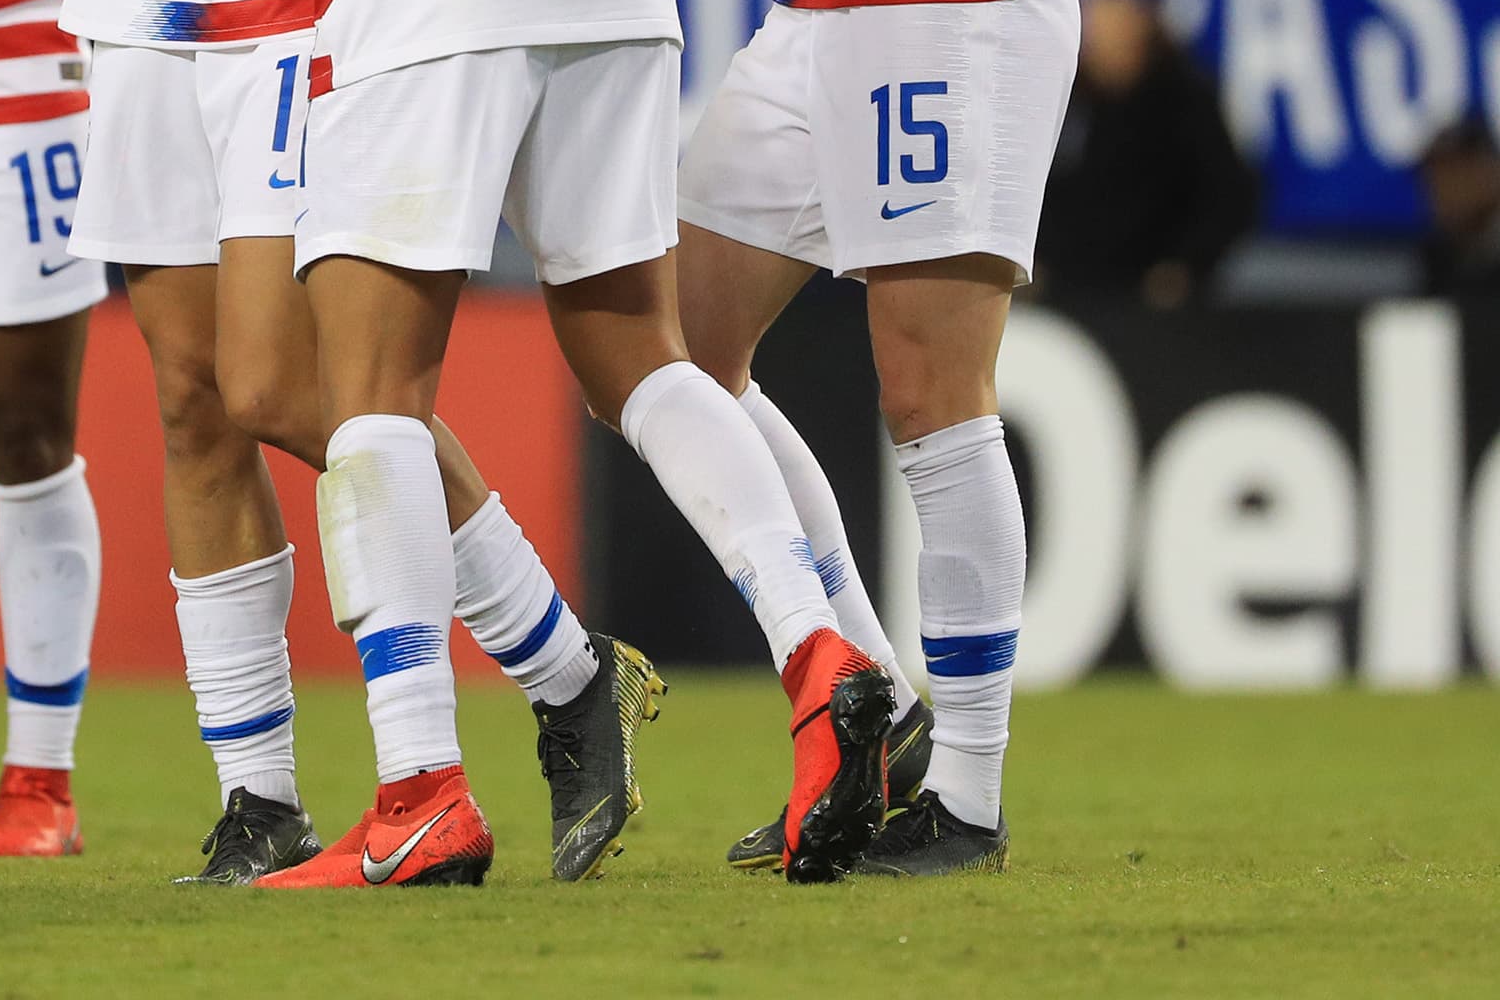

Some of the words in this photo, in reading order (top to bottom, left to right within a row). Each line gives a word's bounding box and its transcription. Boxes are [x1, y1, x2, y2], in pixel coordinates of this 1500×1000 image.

[870, 80, 949, 186] 15
[9, 141, 83, 244] 19
[878, 300, 1500, 692] Del
